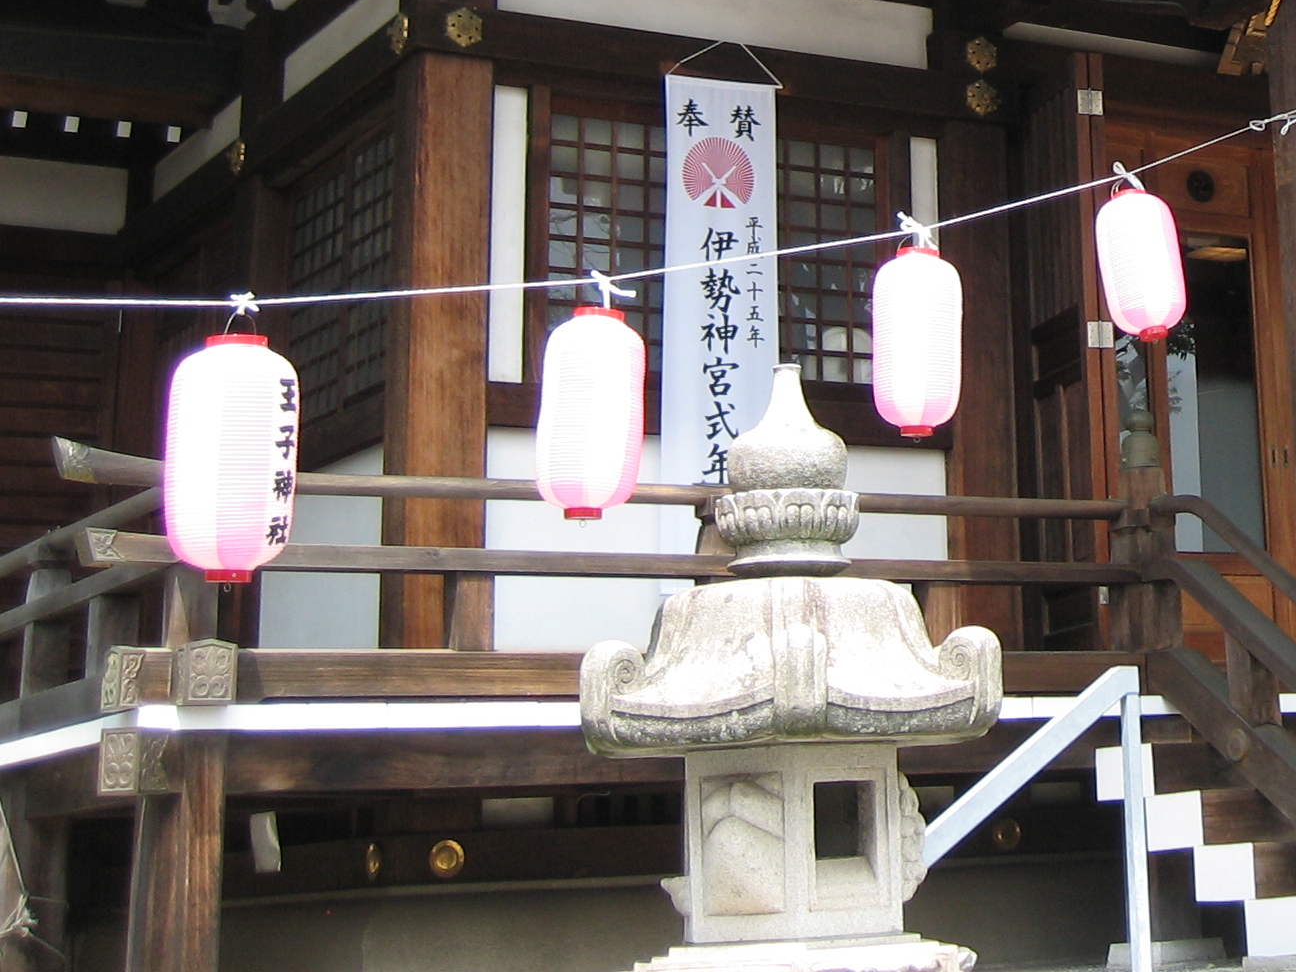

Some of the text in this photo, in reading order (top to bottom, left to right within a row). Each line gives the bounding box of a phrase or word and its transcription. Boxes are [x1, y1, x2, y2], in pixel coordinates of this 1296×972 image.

[676, 98, 761, 142] 奉賛
[699, 226, 740, 484] 伊勢神宮式年
[745, 216, 766, 348] 平成二十五年
[266, 378, 297, 547] 王子神社
